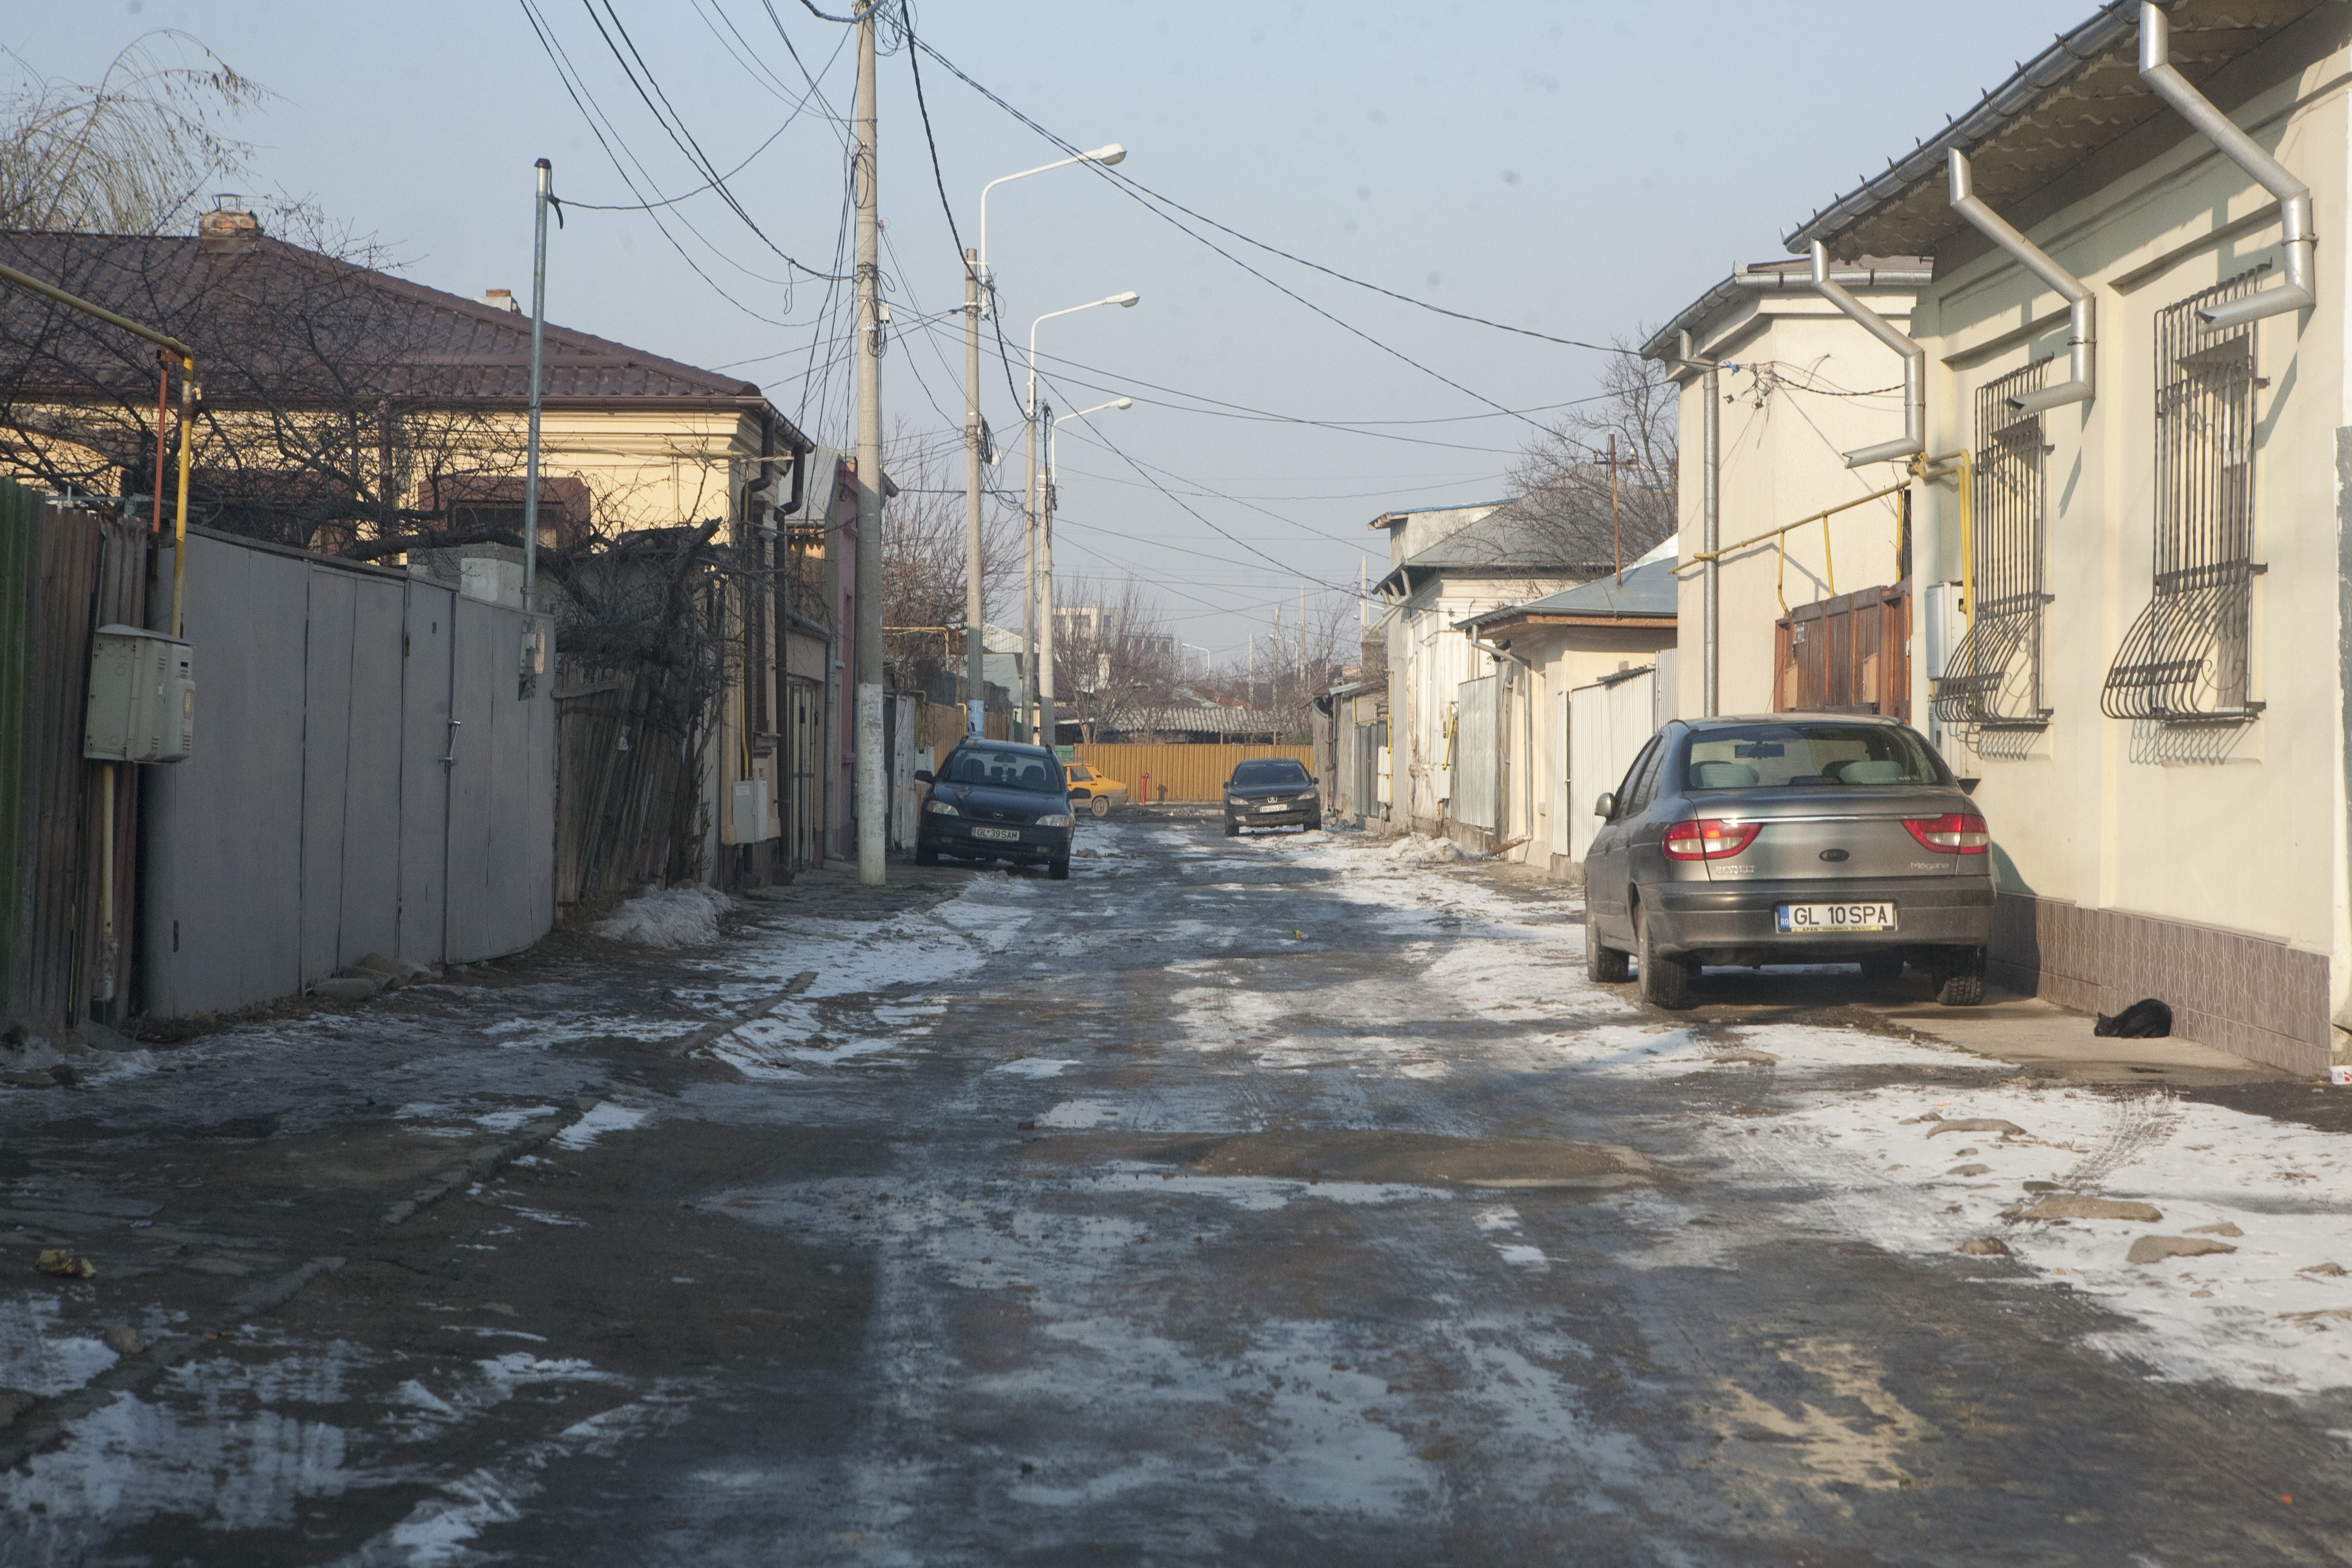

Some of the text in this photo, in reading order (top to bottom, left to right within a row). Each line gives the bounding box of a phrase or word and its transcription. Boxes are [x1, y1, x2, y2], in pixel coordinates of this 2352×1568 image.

[977, 828, 988, 837] GL
[1716, 865, 1755, 873] RENAULT
[1794, 907, 1819, 925] GL
[1849, 906, 1888, 924] SPA
[1781, 918, 1789, 926] RO
